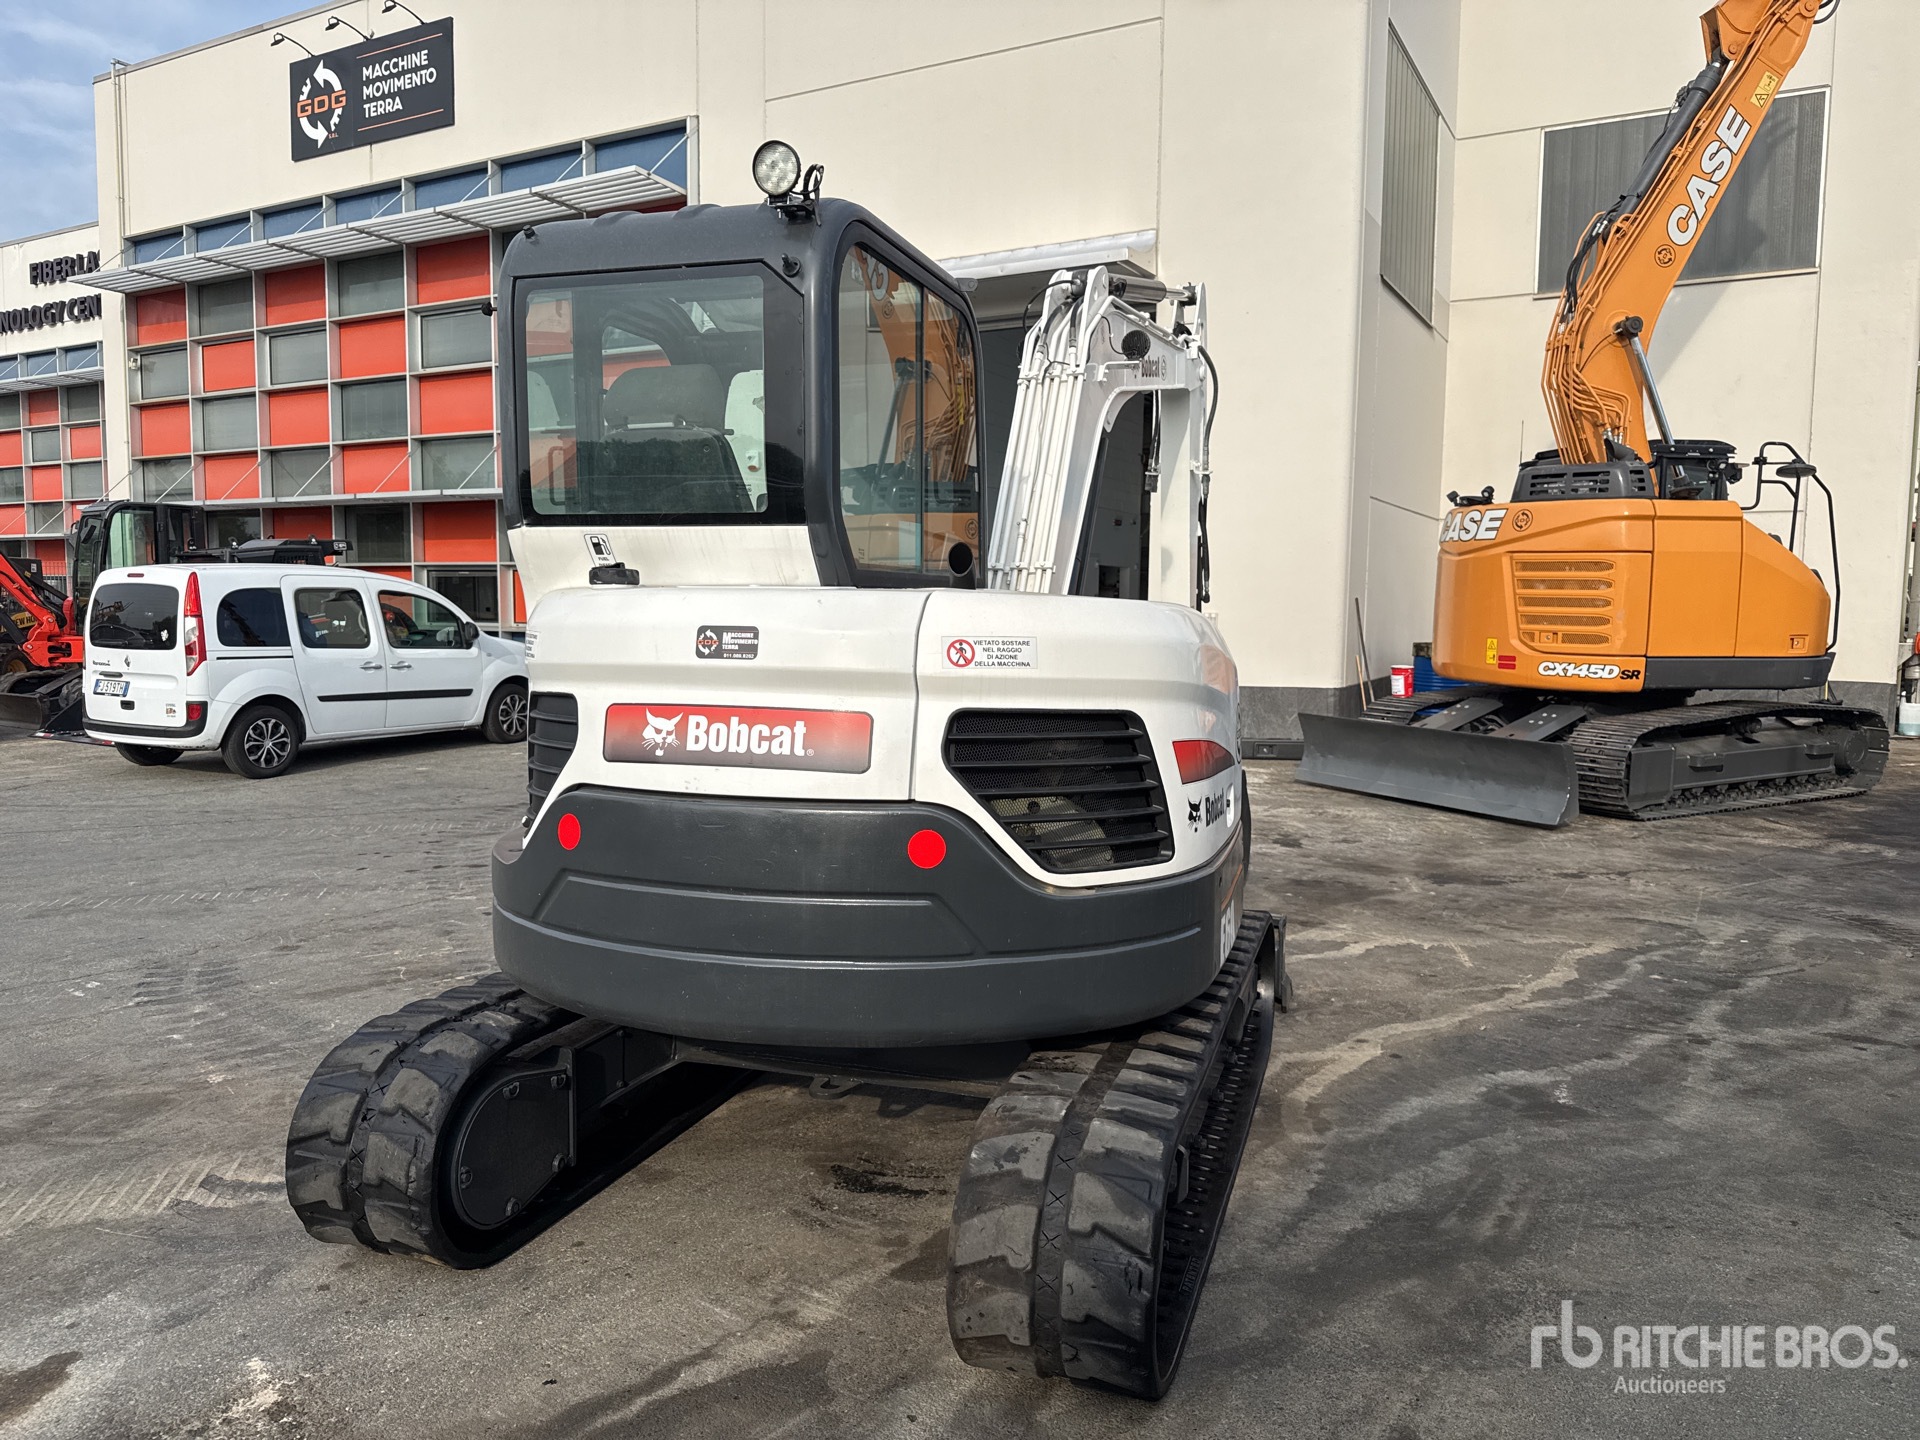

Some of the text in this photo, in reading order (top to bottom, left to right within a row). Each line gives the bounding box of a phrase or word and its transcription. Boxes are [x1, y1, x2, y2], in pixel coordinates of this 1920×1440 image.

[362, 50, 429, 81] MACCHINE
[362, 67, 437, 100] MOVIMENTO
[296, 90, 346, 118] GDG
[363, 96, 403, 118] TERRA
[1666, 103, 1752, 246] CASE
[29, 249, 100, 286] FIBER LA
[1440, 508, 1508, 543] CASE
[1537, 661, 1641, 680] CX145D SR
[686, 714, 806, 757] Bobcat
[1205, 788, 1225, 828] Bobcat
